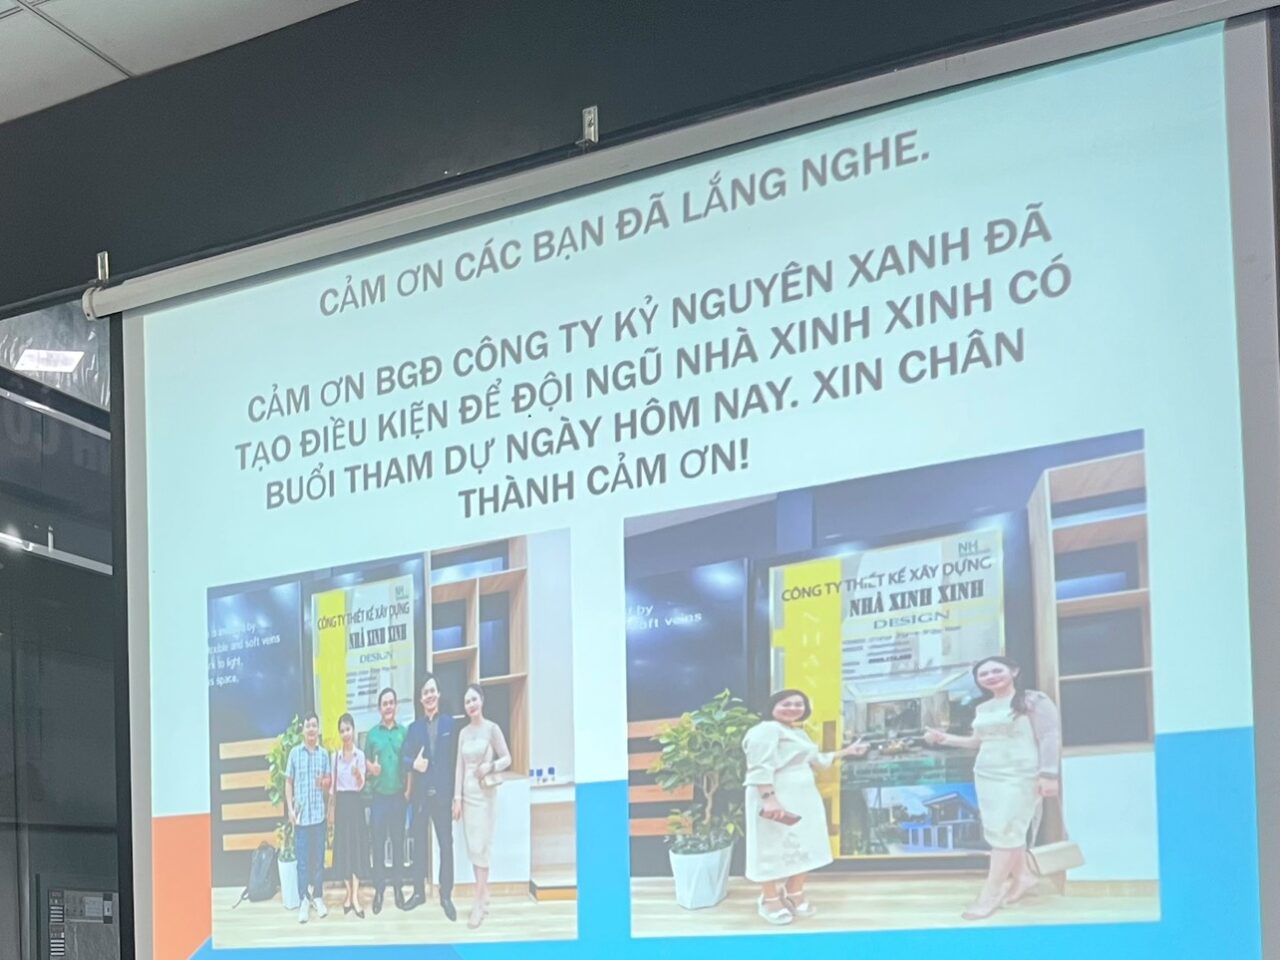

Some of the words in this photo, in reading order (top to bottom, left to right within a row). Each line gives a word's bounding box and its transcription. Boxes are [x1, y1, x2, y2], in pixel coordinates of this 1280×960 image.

[319, 275, 386, 316] CẢM
[397, 258, 443, 297] ƠN
[454, 237, 522, 282] CÁC
[533, 215, 604, 263] BẠN
[615, 191, 670, 240] ĐÃ
[682, 170, 787, 224] LẮNG
[802, 129, 930, 191] NGHE.
[235, 434, 291, 472] TẠO
[300, 416, 367, 458] ĐIỀU
[378, 399, 448, 442] KIỆN
[459, 378, 502, 425] ĐỂ
[512, 371, 573, 413] ĐỘI
[586, 347, 662, 398] NGŨ
[676, 326, 759, 379] NHÀ
[770, 306, 870, 360] XINH
[885, 278, 992, 334] XINH
[1009, 253, 1072, 305] CÓ
[247, 383, 310, 423] CẢM
[320, 371, 365, 407] ƠN
[376, 355, 443, 395] BGĐ
[453, 330, 549, 377] CÔNG
[559, 315, 603, 353] TY
[615, 295, 659, 342] KỶ
[672, 260, 833, 328] NGUYÊN
[848, 227, 969, 288] XANH
[984, 202, 1052, 255] ĐÃ
[266, 462, 335, 510] BUỔI
[344, 450, 433, 493] THAM
[445, 438, 495, 475] DỰ
[507, 416, 602, 464] NGÀY
[615, 396, 700, 442] HÔM
[715, 376, 799, 423] NAY.
[812, 357, 883, 404] XIN
[899, 327, 1024, 384] CHÂN
[458, 470, 575, 519] THÀNH
[587, 451, 667, 495] CẢM
[680, 437, 749, 479] ƠN!
[781, 582, 822, 602] CÔNG
[825, 581, 843, 595] TY
[888, 566, 907, 584] KẾ
[910, 563, 939, 582] XÂY
[942, 556, 993, 577] DỰNG
[849, 591, 885, 618] NHÀ
[889, 587, 933, 616] XINH
[937, 578, 985, 605] XINH
[873, 610, 951, 630] DESIGN
